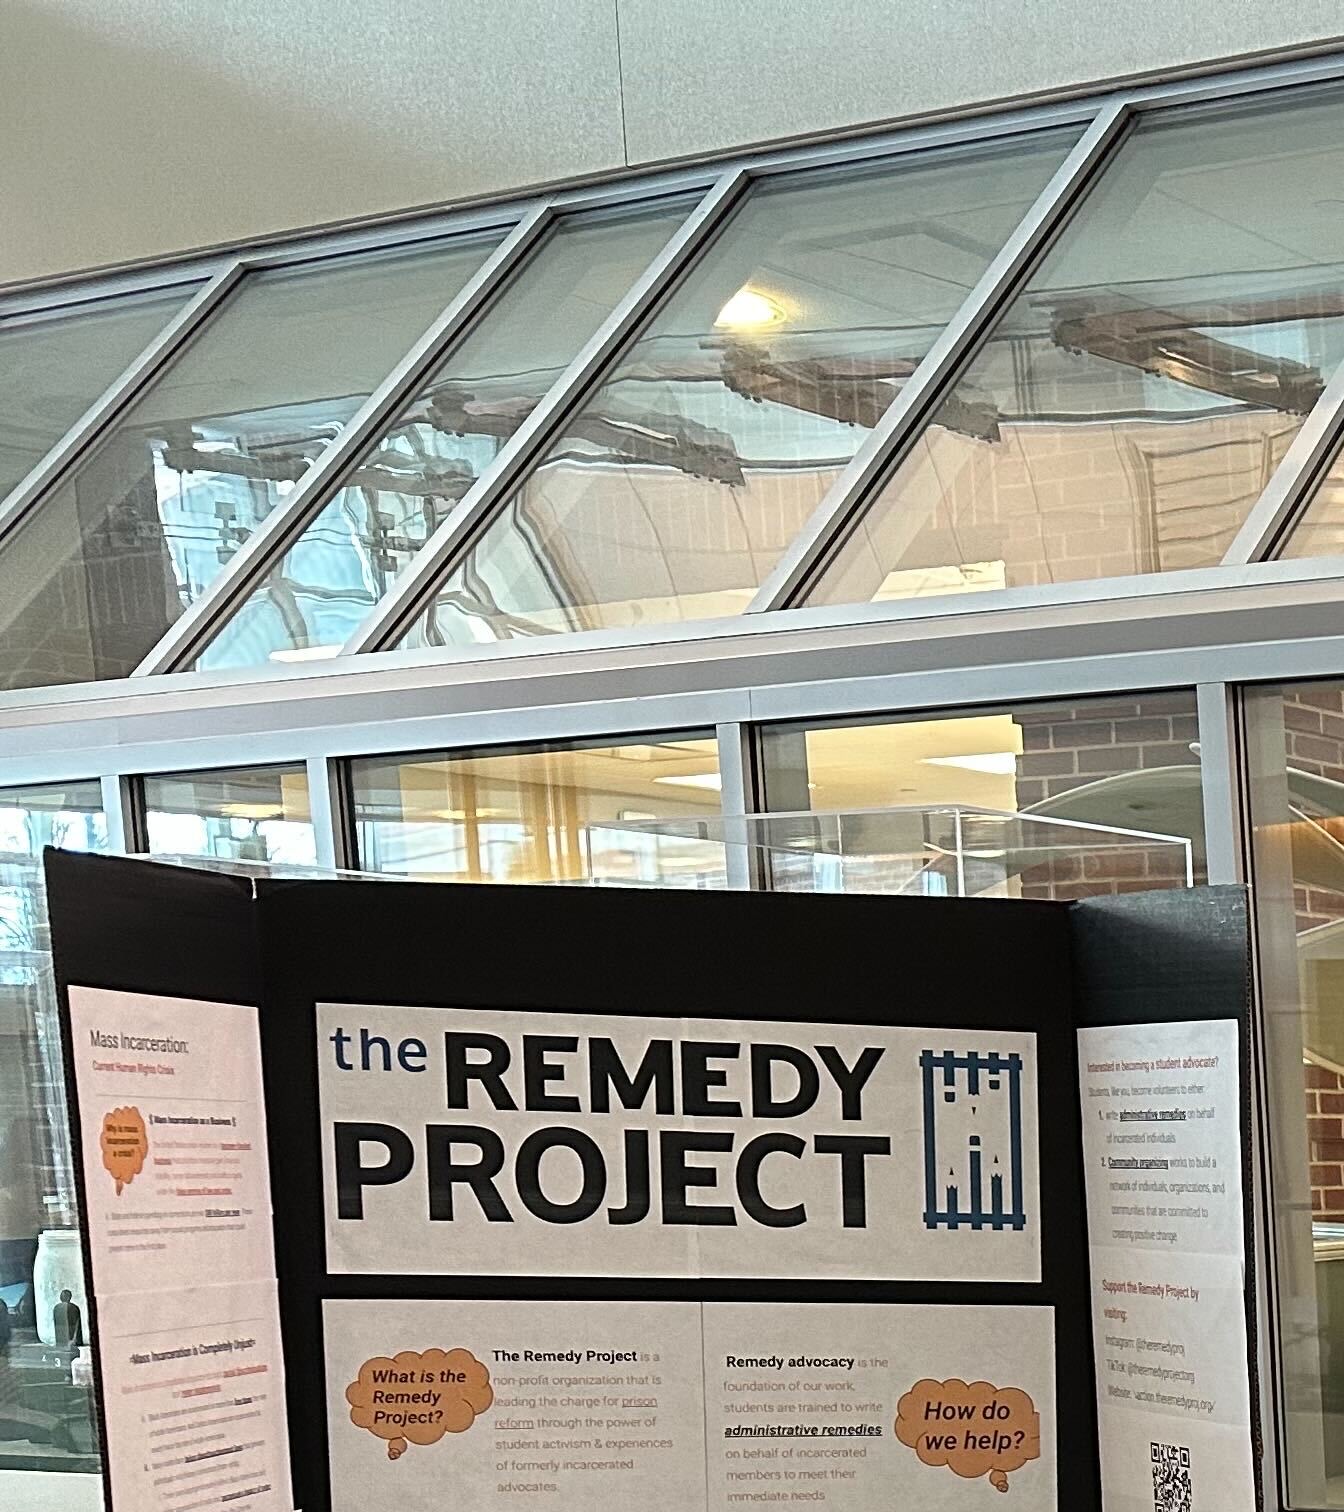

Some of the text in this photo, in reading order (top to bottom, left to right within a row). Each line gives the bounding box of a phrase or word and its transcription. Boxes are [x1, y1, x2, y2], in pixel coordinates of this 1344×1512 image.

[90, 1030, 118, 1049] Mass
[330, 1027, 885, 1120] the REMEDY
[333, 1121, 891, 1228] PROJECT
[492, 1350, 520, 1362] The
[524, 1350, 582, 1364] Remedy
[586, 1351, 638, 1364] Project
[726, 1356, 784, 1370] Remedy
[788, 1356, 855, 1370] advocacy
[372, 1369, 466, 1383] What is the
[626, 1375, 649, 1385] that
[374, 1391, 441, 1406] Remedy
[924, 1402, 1010, 1420] How do
[374, 1410, 443, 1427] Project?
[494, 1417, 657, 1430] reform through the power of
[724, 1425, 883, 1436] administrative remedies
[925, 1430, 1025, 1454] we help?
[496, 1459, 634, 1472] of formerly incarcerated
